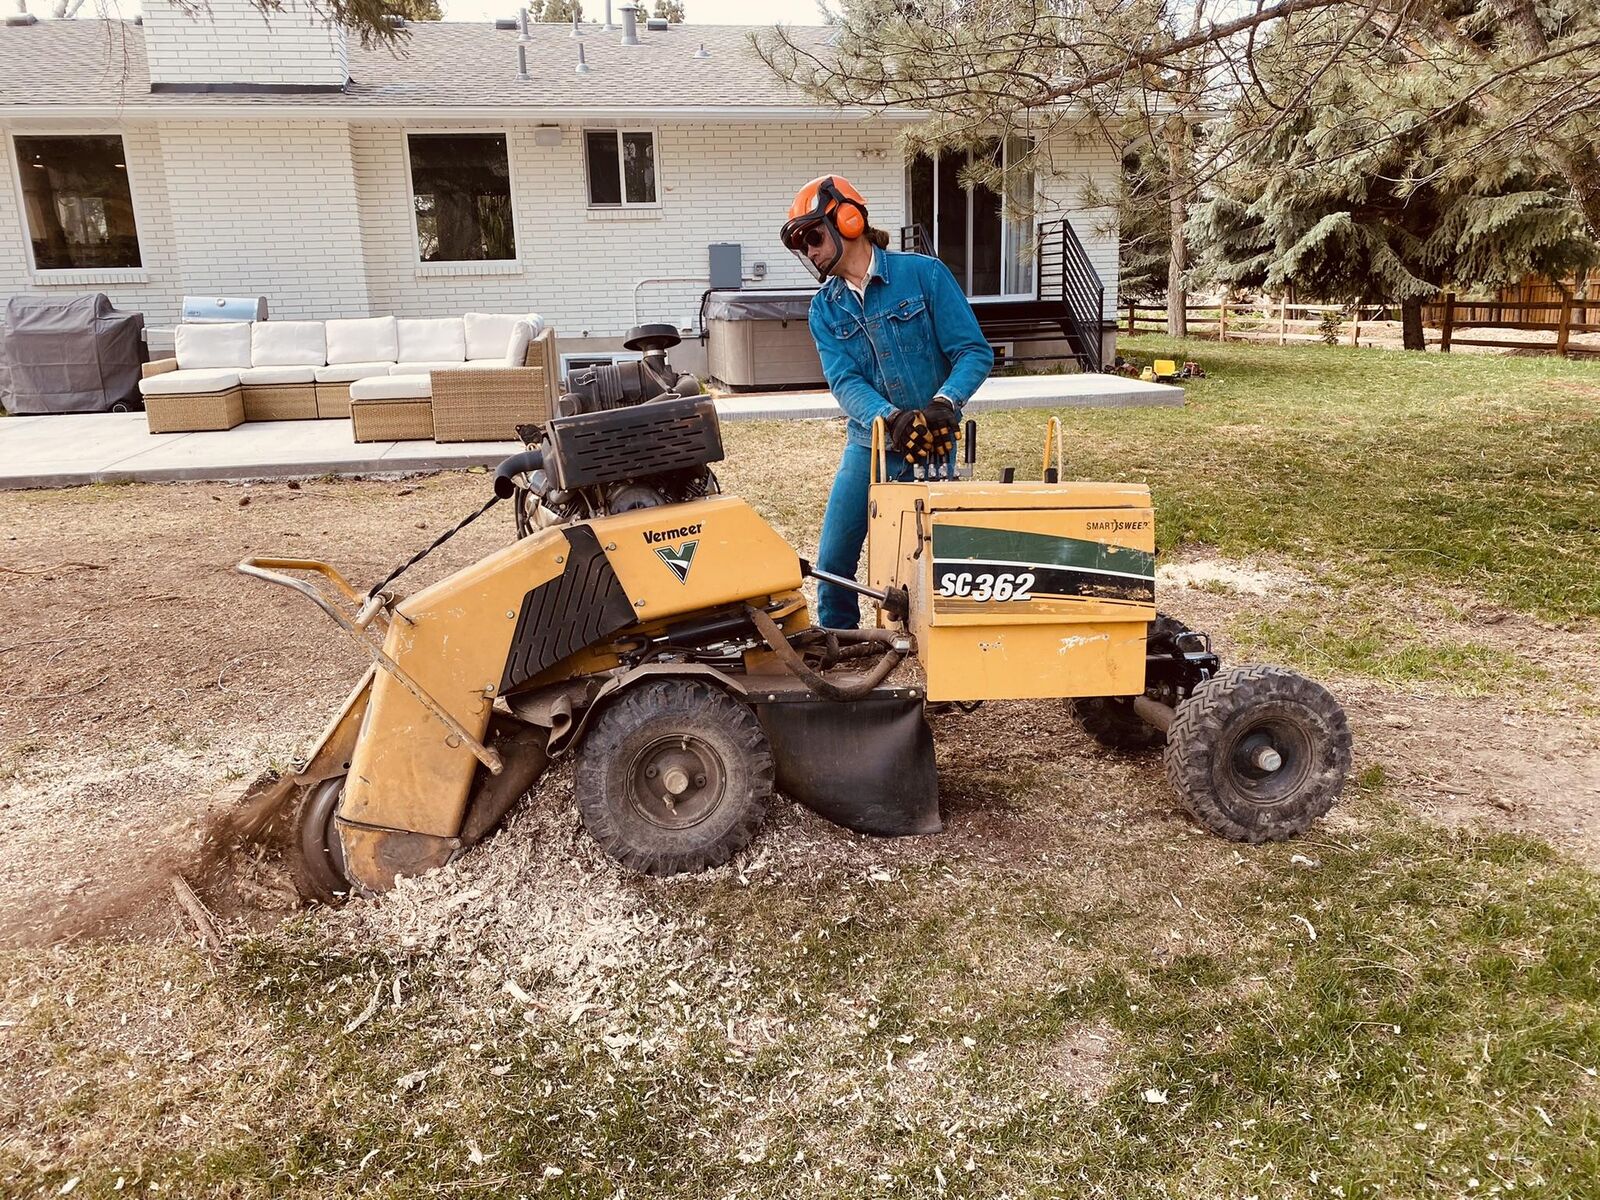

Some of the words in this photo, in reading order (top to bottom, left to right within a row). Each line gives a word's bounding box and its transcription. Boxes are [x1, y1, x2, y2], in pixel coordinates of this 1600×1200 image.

[643, 523, 702, 544] Vermeer
[1086, 521, 1114, 530] SMART
[939, 572, 1036, 602] SC362
